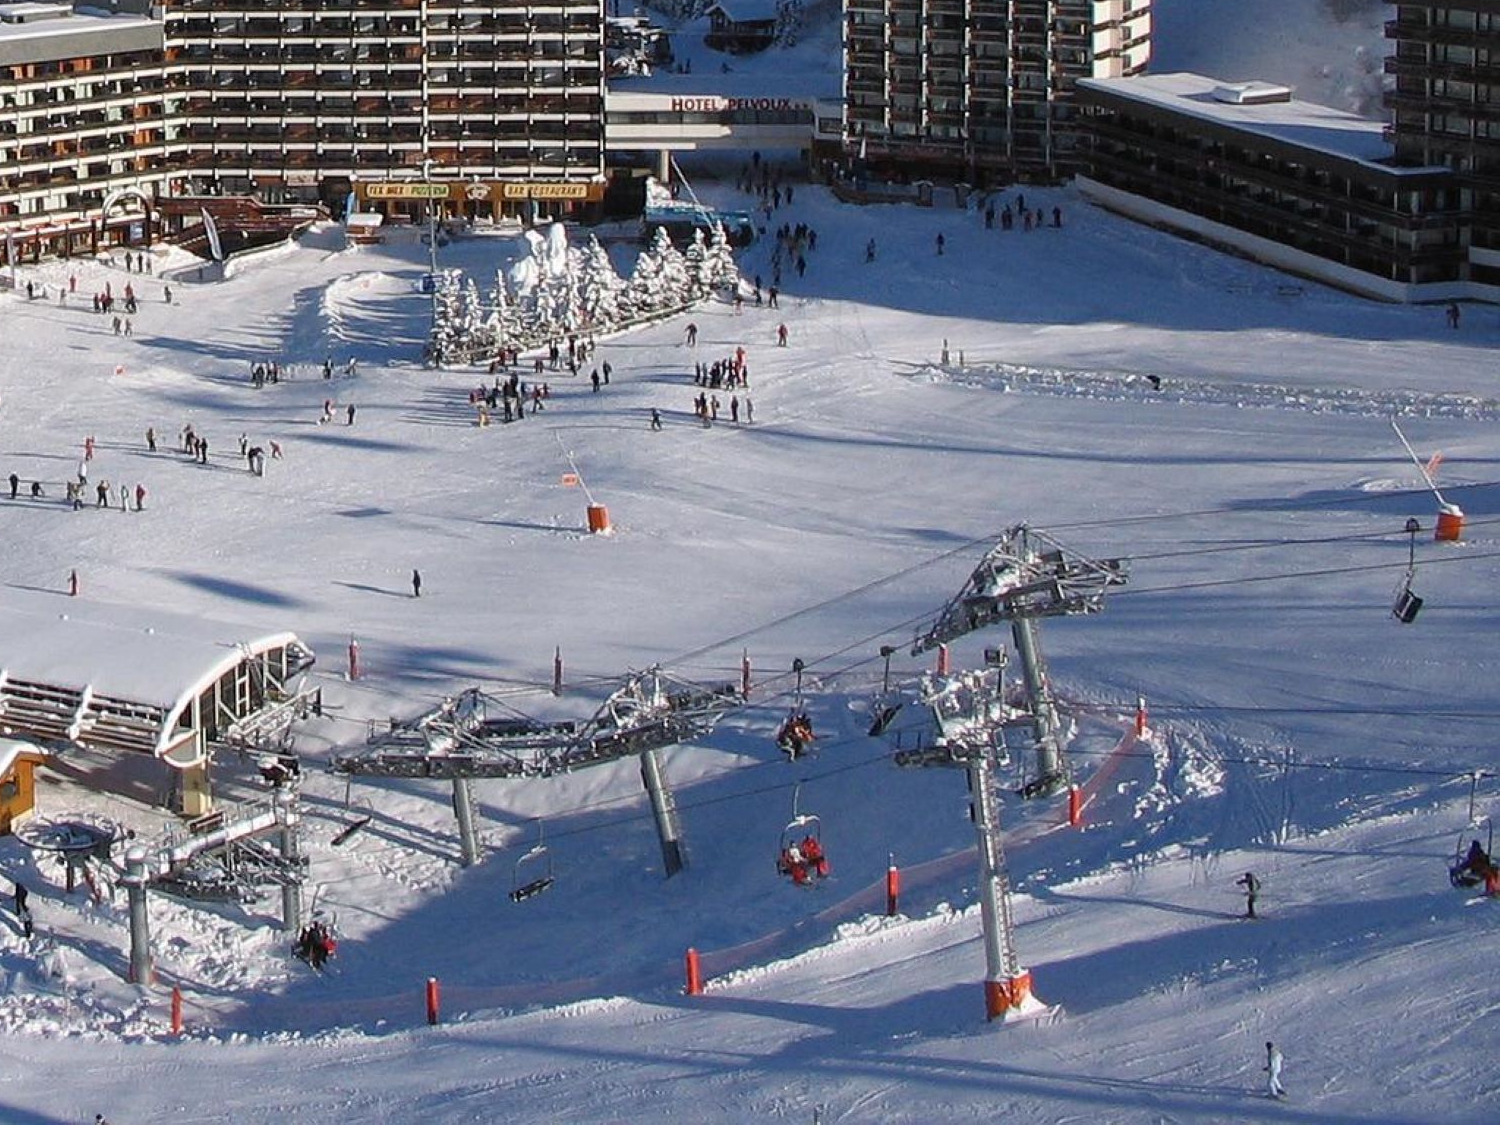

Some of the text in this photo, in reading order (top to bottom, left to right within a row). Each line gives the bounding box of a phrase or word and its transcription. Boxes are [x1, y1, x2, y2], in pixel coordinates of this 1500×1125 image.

[672, 98, 791, 111] HOTEL PELVOUX
[507, 186, 525, 195] BAR
